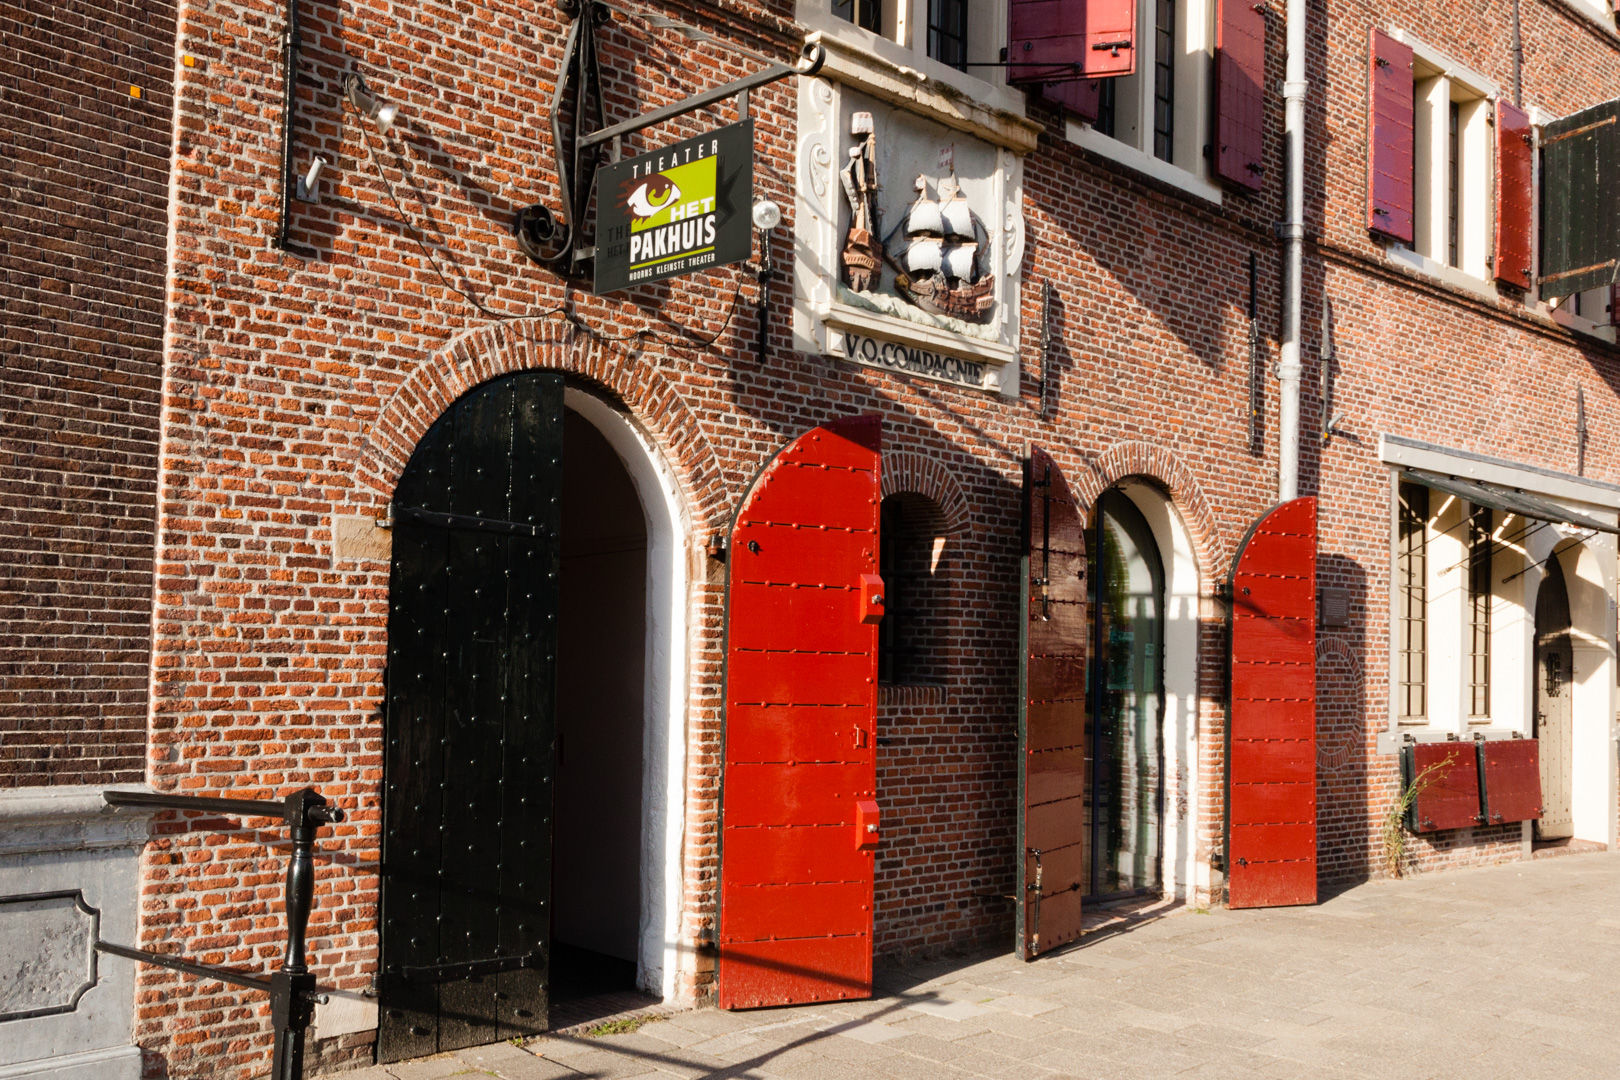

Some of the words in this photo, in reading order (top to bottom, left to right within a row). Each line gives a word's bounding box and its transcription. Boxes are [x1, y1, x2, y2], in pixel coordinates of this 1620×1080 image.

[633, 139, 718, 180] THEATER
[670, 196, 714, 222] HET
[630, 215, 716, 263] PAKHUIS
[629, 268, 653, 281] HOORNS
[657, 260, 685, 274] KLEINSTE
[689, 253, 716, 267] THEATER
